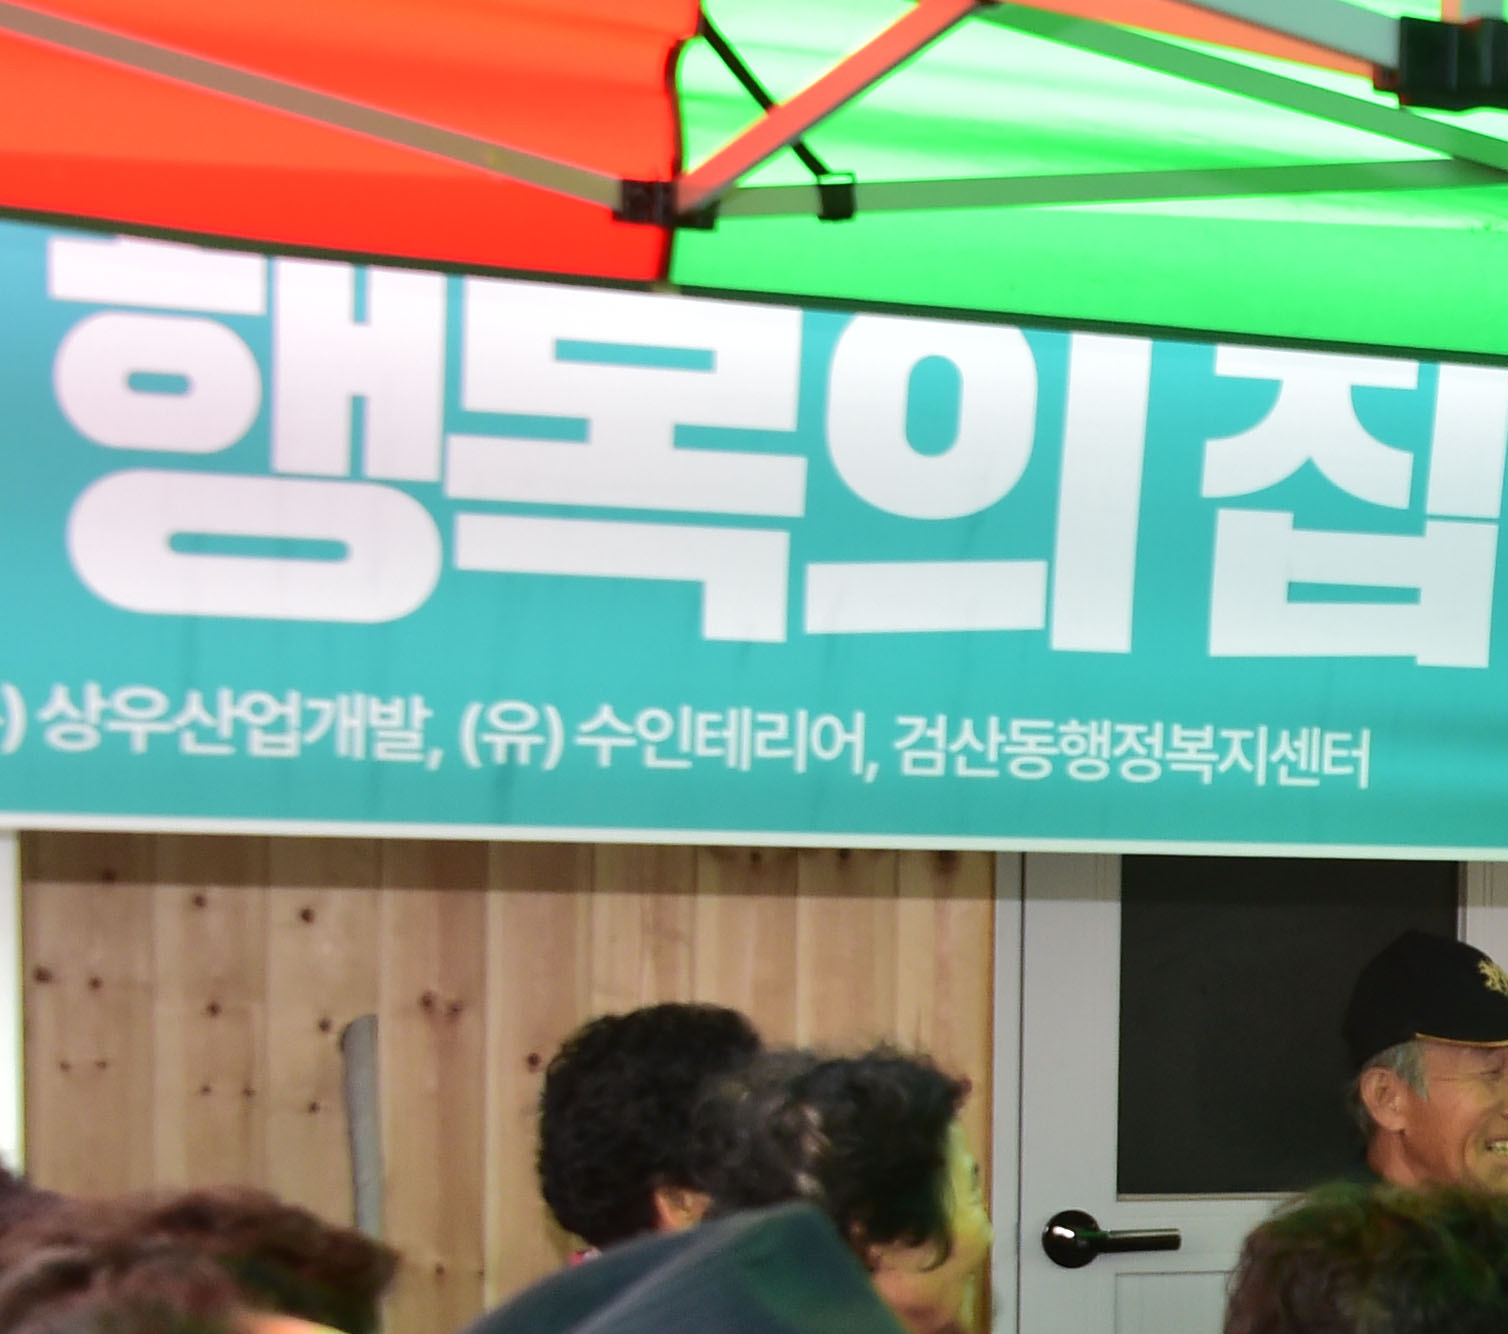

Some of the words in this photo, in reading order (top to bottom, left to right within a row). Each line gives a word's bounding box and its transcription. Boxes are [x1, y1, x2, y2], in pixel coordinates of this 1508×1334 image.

[36, 680, 445, 771] 상우산업개발,
[460, 702, 566, 771] (유)
[575, 703, 881, 783] 수인테리어,
[892, 713, 1372, 789] 검산동행정복지센터
